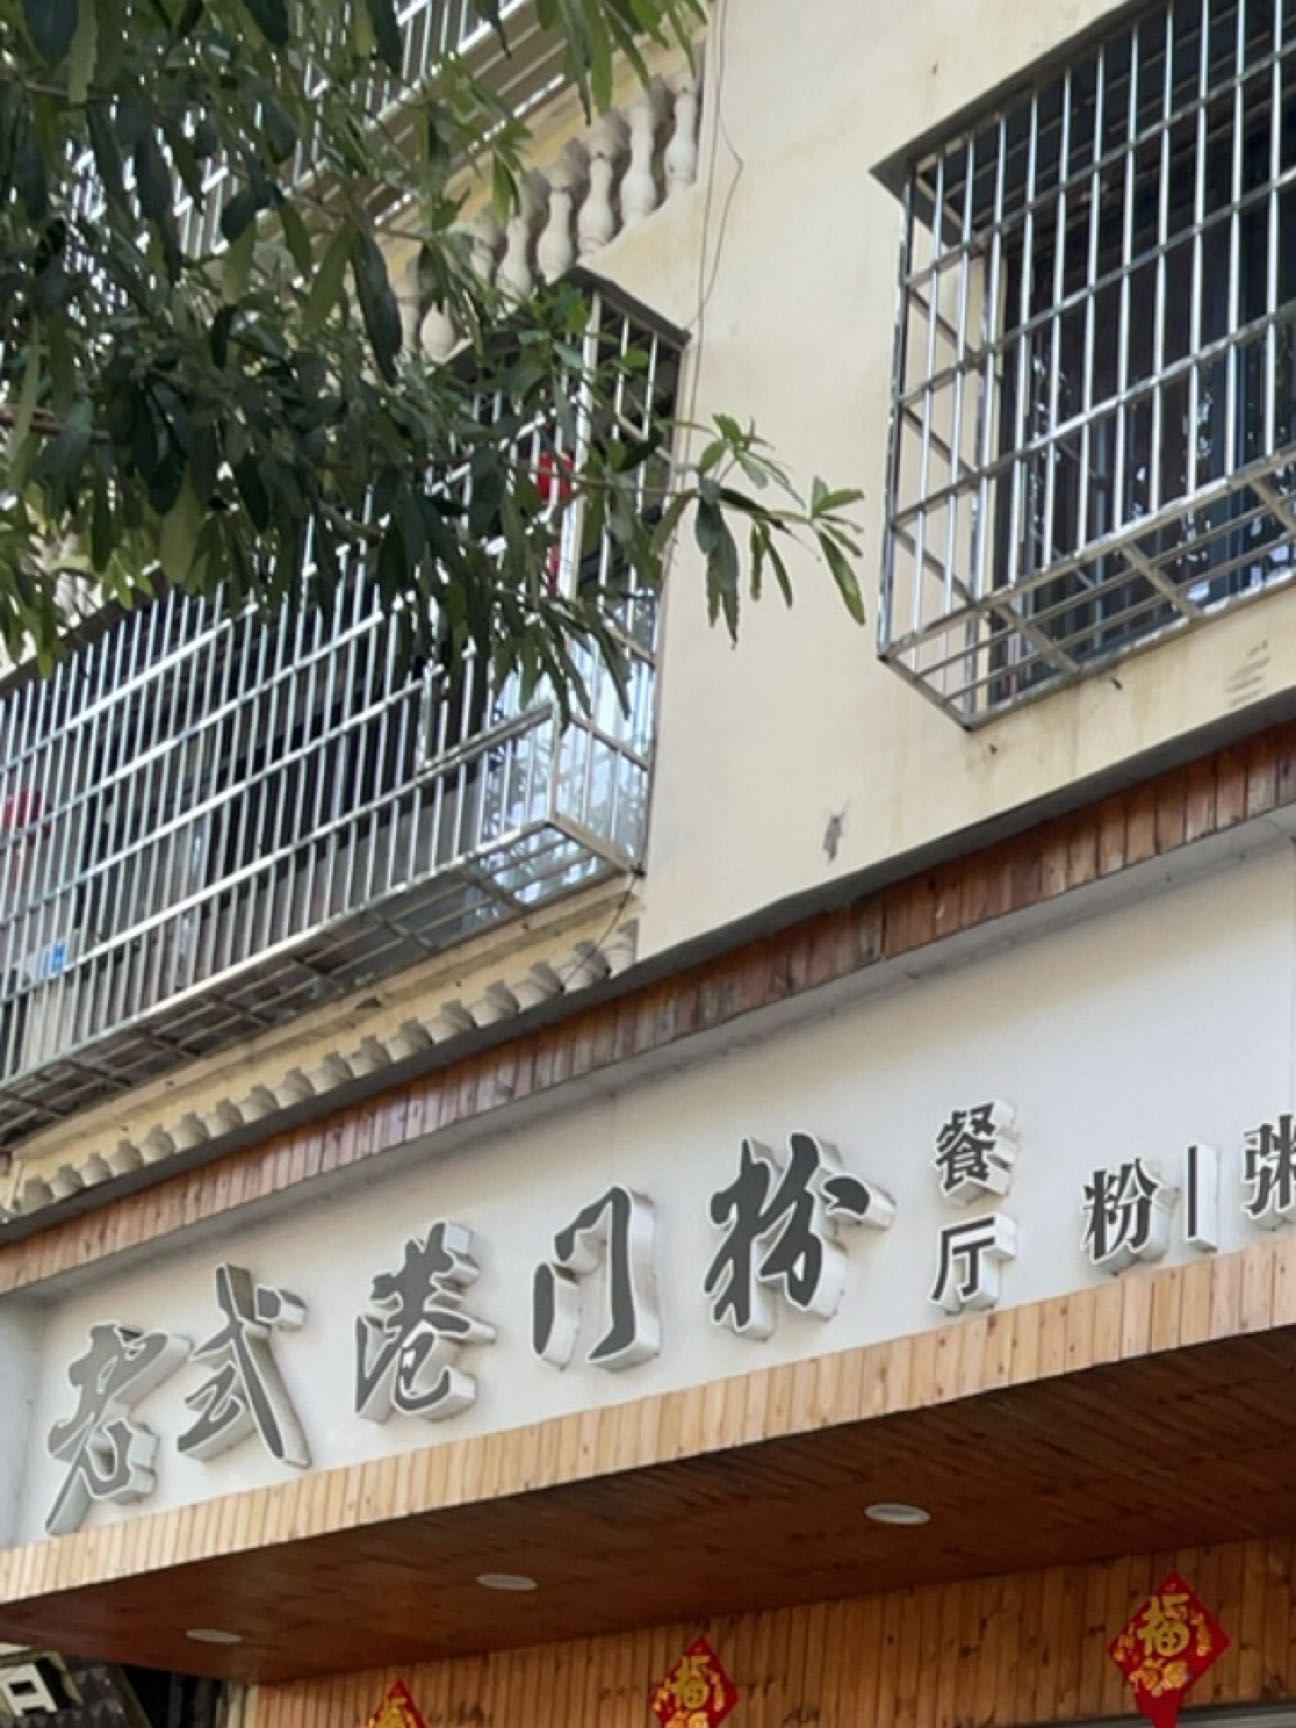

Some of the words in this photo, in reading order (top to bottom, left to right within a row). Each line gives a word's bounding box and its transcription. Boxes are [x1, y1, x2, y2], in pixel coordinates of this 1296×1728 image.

[42, 1132, 885, 1536] 老式港门粉
[933, 1102, 1010, 1308] 餐厅
